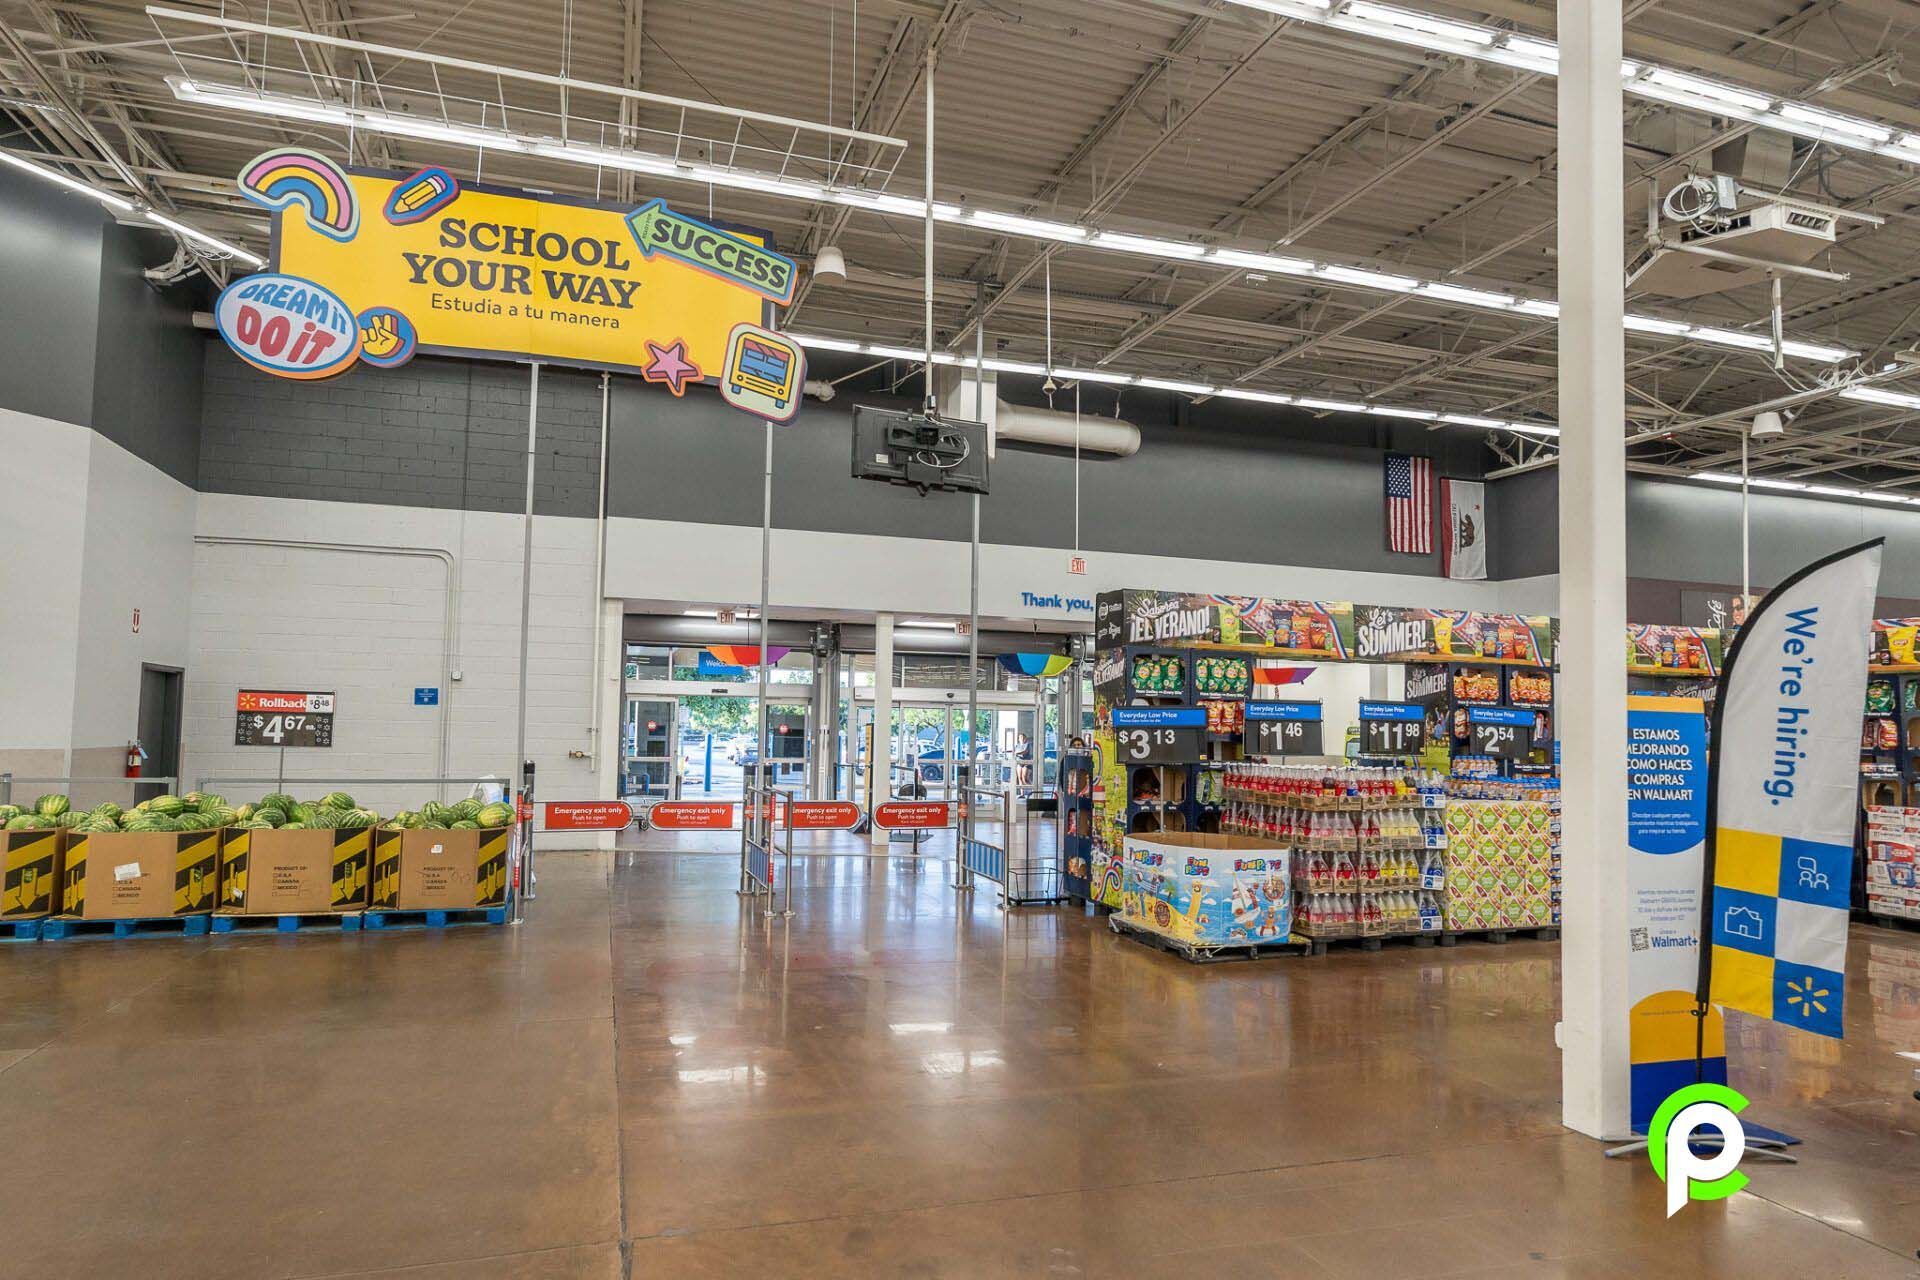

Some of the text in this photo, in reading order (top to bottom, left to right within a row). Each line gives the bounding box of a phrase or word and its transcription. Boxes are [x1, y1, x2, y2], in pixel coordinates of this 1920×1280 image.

[439, 217, 630, 271] SCHOOL
[651, 218, 787, 288] SUCCESS
[402, 252, 641, 309] YOUR WAY
[237, 283, 329, 324] DREAM
[431, 293, 620, 329] Estudia a tu manera
[236, 304, 291, 357] DO
[1071, 559, 1085, 573] EXIT
[1021, 592, 1062, 608] Thank
[1066, 599, 1094, 612] you,
[720, 612, 735, 624] EXIT
[1154, 605, 1210, 640] VERANO!
[1369, 608, 1393, 630] Let's
[958, 623, 971, 634] EXIT
[1358, 619, 1428, 657] SUMMER!
[1407, 673, 1447, 699] SUMMER!
[259, 698, 306, 708] Rollback
[1633, 728, 1680, 740] ESTAMOS
[1660, 760, 1693, 770] HACES
[1763, 707, 1810, 806] hiring.
[1634, 774, 1685, 785] COMPRAS
[1628, 789, 1693, 800] EN WALMART
[554, 807, 592, 815] Emergency
[1187, 857, 1208, 866] FUN
[1651, 936, 1698, 948] Walmart+
